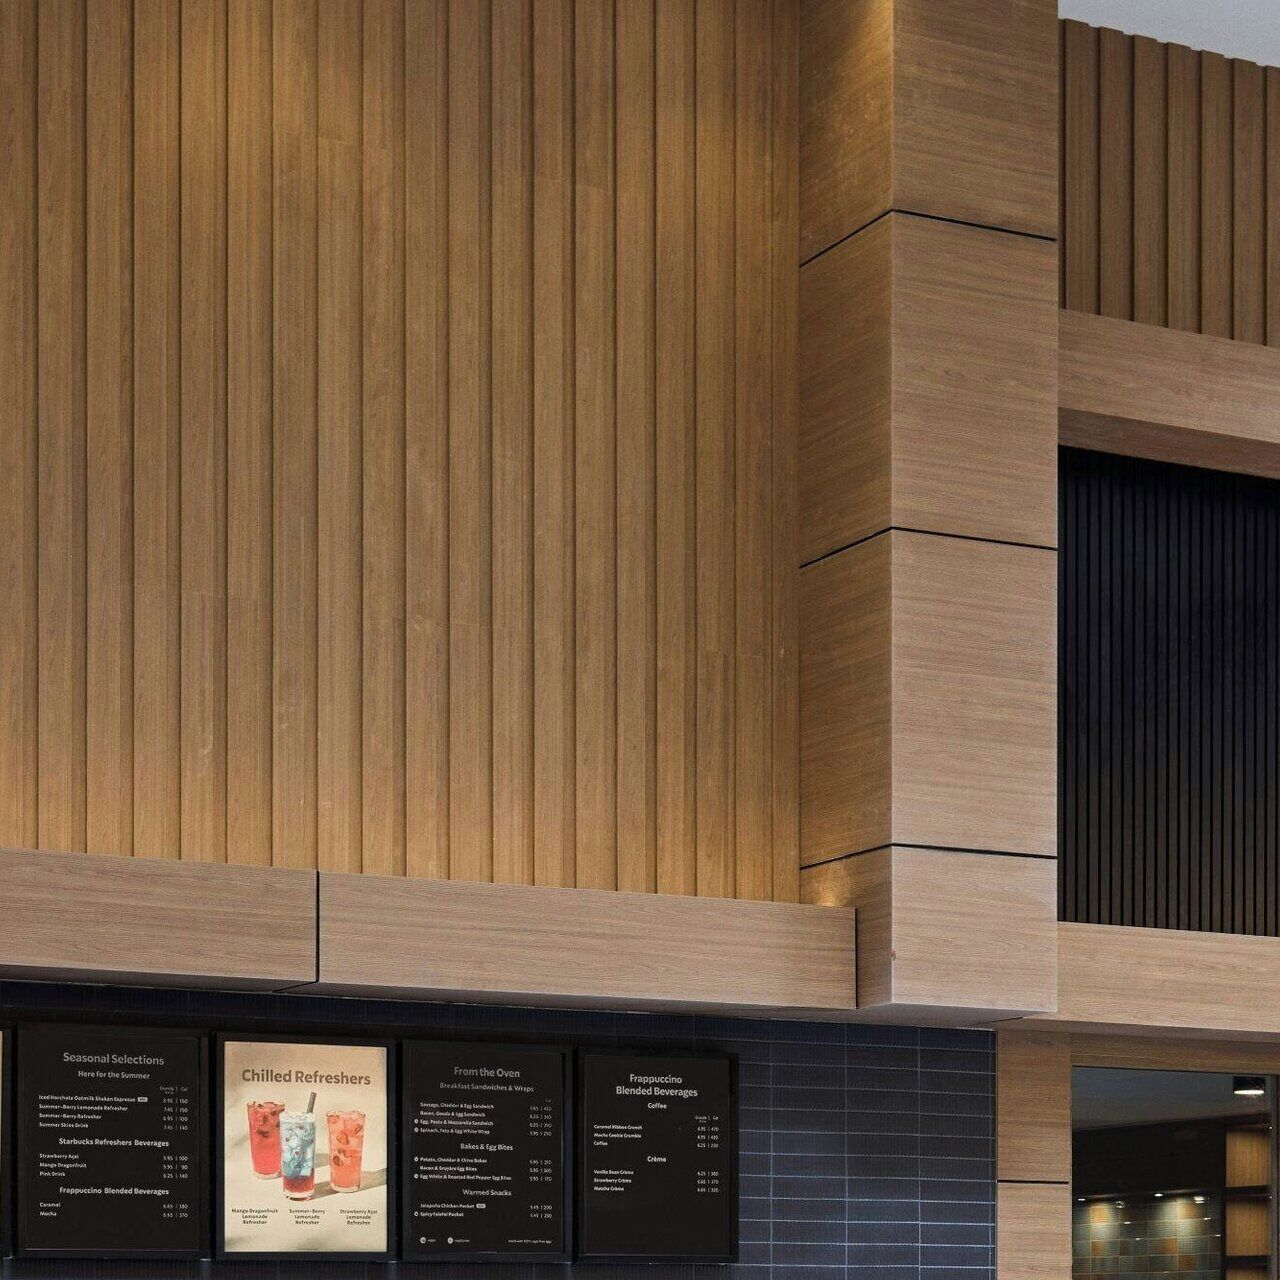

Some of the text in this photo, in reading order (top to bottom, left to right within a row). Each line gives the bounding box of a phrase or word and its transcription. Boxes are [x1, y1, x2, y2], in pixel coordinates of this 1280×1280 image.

[63, 1052, 164, 1065] Seasonal Selections
[242, 1069, 371, 1085] Chilled Refreshers
[454, 1066, 520, 1077] From the Oven
[630, 1074, 682, 1084] Frappuccino
[440, 1082, 472, 1090] Breakfast
[471, 1083, 507, 1091] Sandwiches
[514, 1085, 534, 1093] Wraps
[616, 1086, 698, 1098] Blended Beverages
[94, 1138, 132, 1146] Refreshers
[134, 1139, 169, 1147] Beverages
[59, 1187, 102, 1195] Frappuccino
[134, 1188, 169, 1196] Beverages
